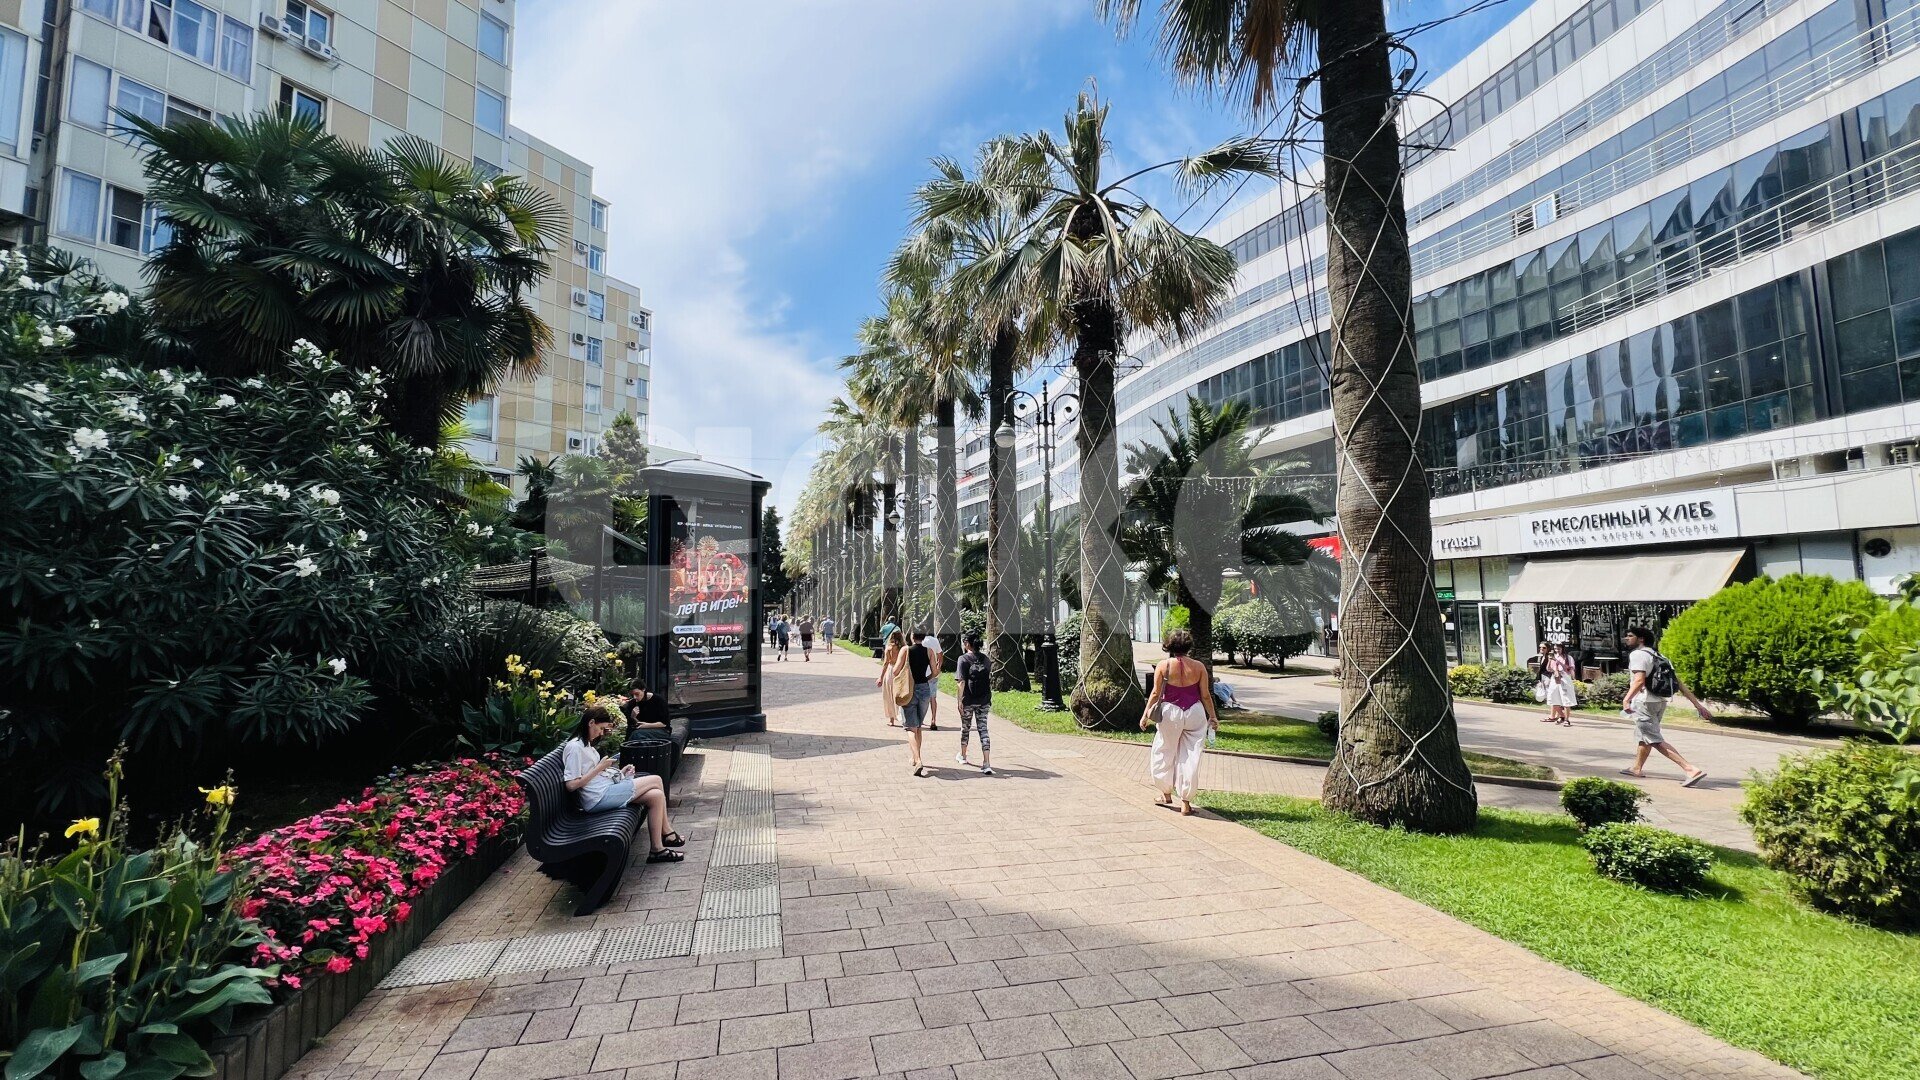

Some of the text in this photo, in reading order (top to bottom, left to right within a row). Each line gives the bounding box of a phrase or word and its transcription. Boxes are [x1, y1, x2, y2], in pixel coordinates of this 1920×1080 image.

[1532, 500, 1713, 534] РЕМЕСЛЕННЫЙ ХЛЕБ
[676, 595, 740, 616] лет в игре!
[1546, 616, 1571, 632] ICE
[678, 637, 703, 648] 20+
[712, 635, 740, 646] 170+
[1547, 632, 1571, 643] КОФЕ
